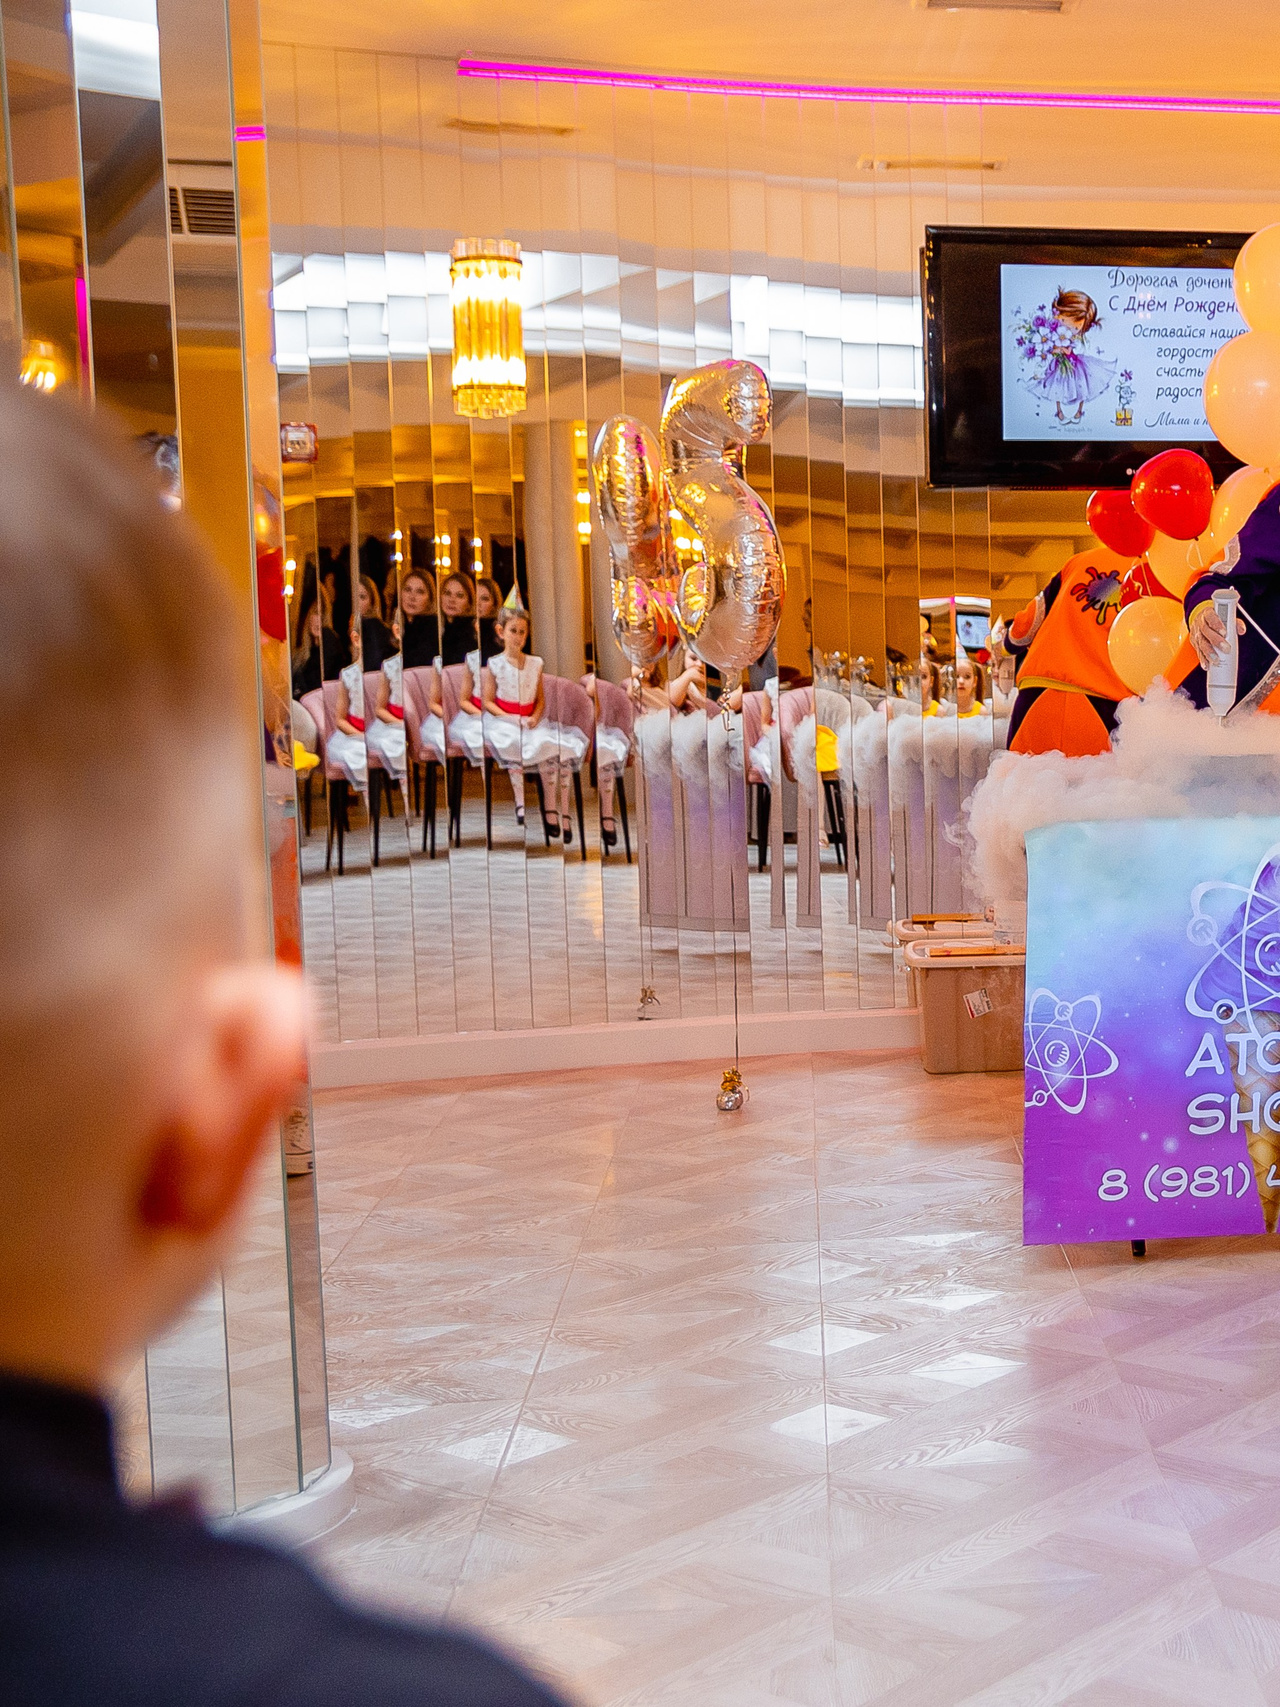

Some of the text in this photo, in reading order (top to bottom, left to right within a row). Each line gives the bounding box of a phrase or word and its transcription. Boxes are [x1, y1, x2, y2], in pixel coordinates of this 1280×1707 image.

[1108, 266, 1178, 292] Дорогая
[1109, 295, 1119, 311] С
[1123, 296, 1167, 314] Днём
[1133, 324, 1249, 339] Оставайся наше
[1144, 411, 1190, 428] Мама
[1098, 1168, 1129, 1201] 8
[1143, 1161, 1251, 1203] (981)
